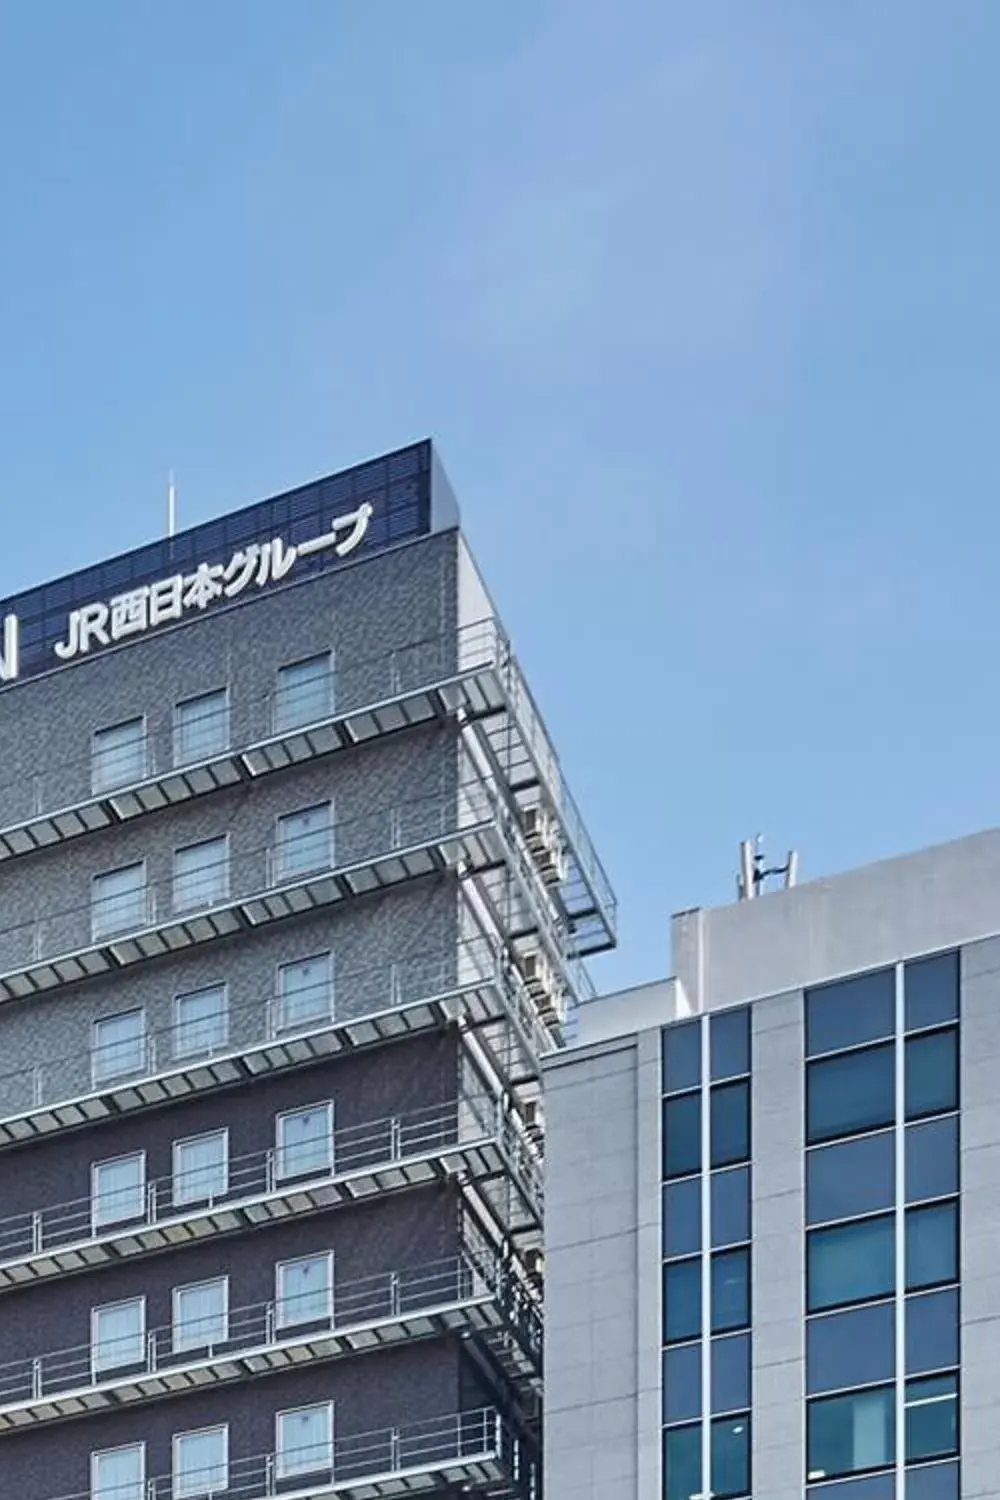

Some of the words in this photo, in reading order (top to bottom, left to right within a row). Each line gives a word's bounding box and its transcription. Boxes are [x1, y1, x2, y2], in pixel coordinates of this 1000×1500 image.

[54, 502, 373, 660] JR西日本グループ
